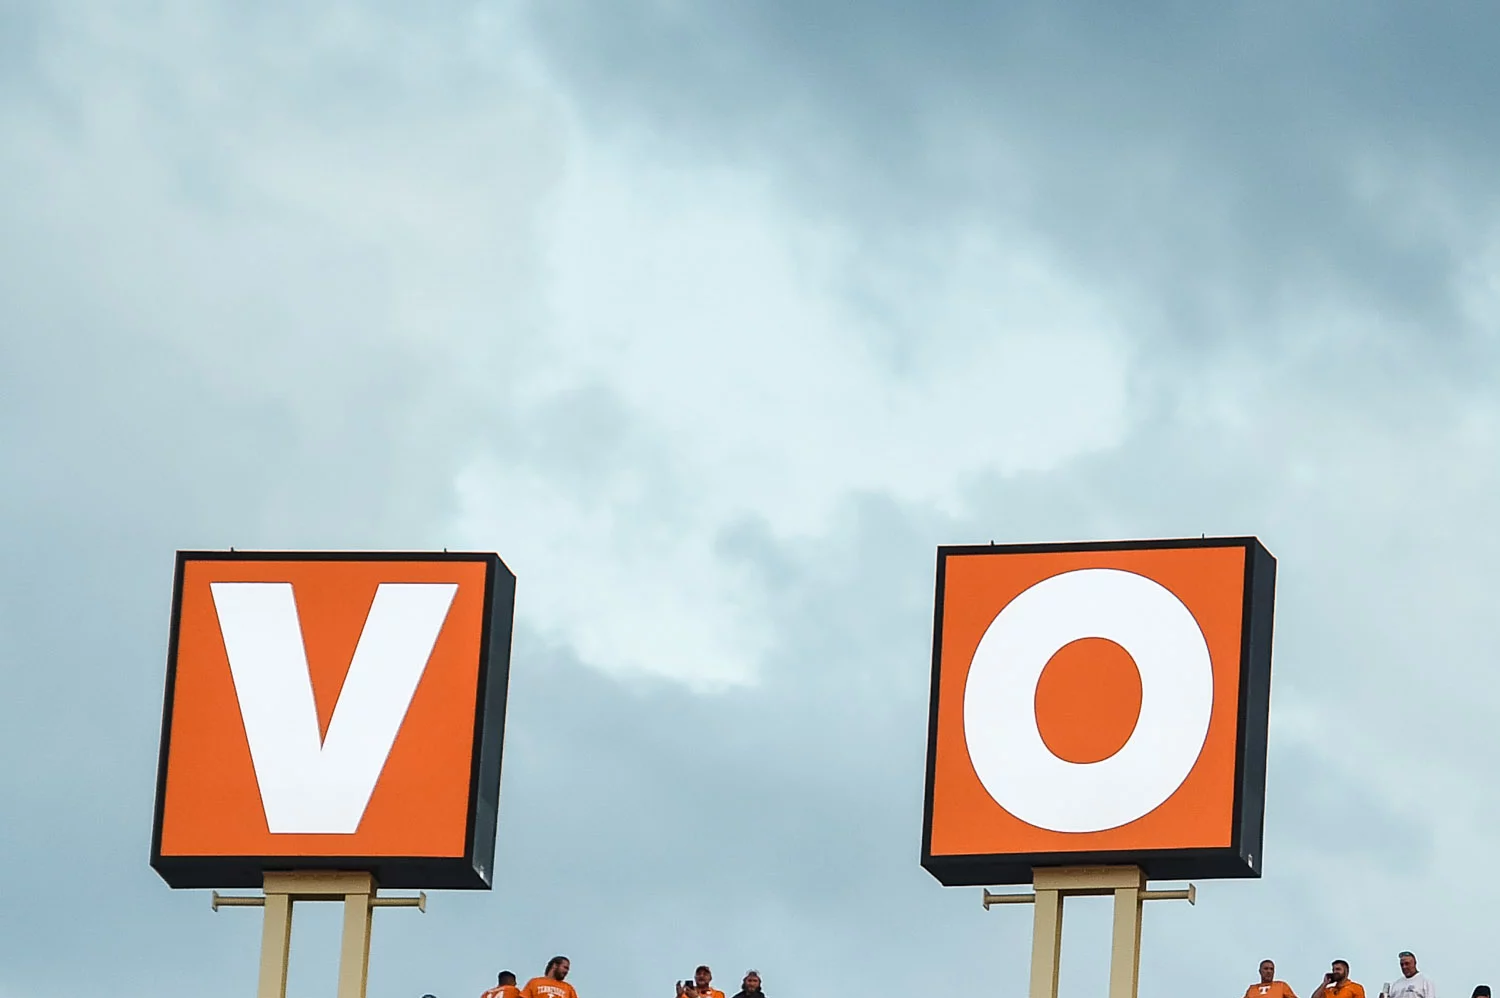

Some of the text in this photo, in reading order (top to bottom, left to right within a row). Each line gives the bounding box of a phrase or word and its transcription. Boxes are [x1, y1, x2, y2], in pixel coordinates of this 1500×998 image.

[210, 583, 458, 833] V
[964, 569, 1213, 832] O
[1259, 986, 1270, 994] T
